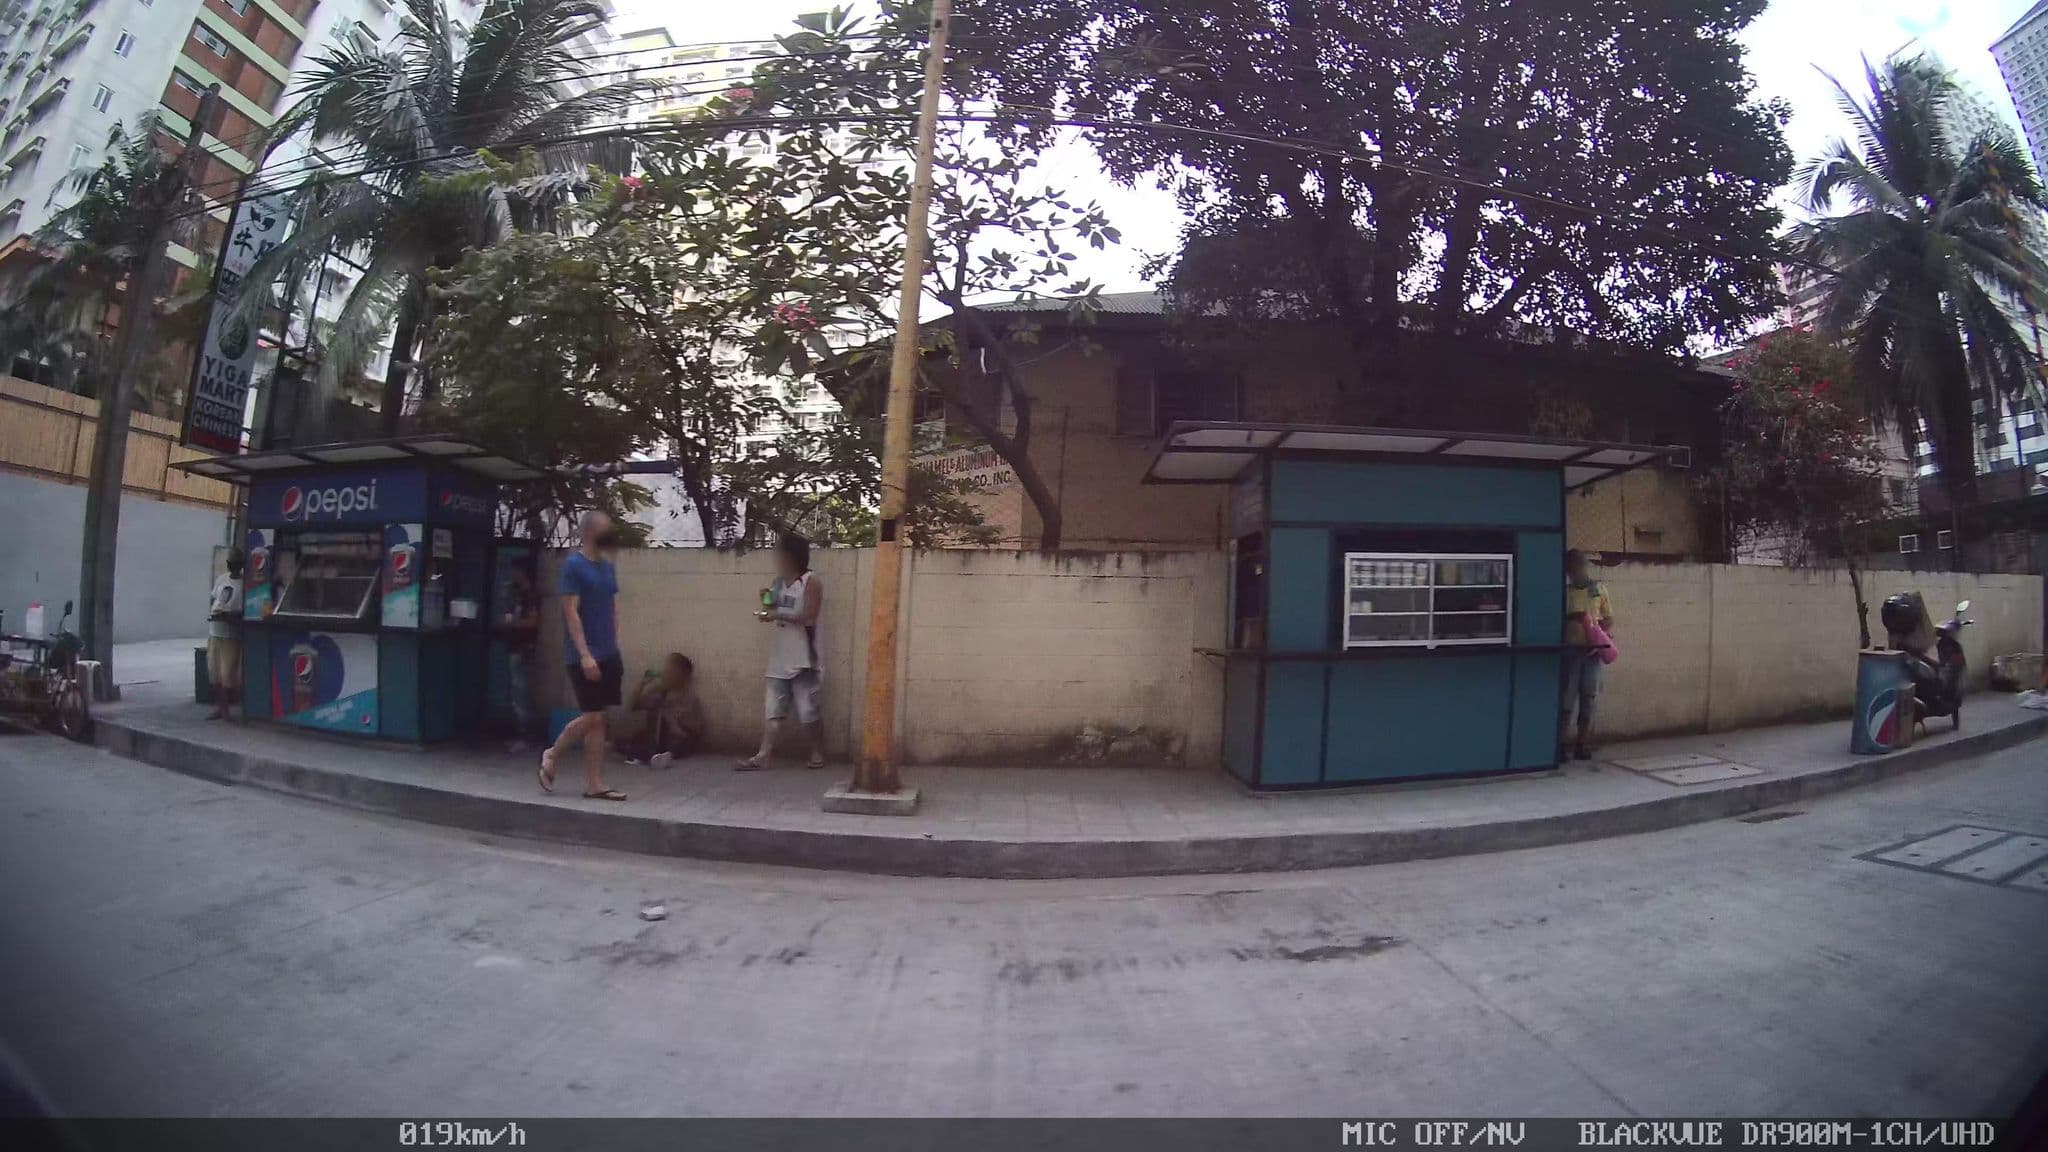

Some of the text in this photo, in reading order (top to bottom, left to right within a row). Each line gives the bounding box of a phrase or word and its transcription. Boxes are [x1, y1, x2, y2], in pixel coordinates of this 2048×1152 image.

[205, 355, 247, 388] YIGA
[200, 375, 248, 406] MART
[195, 397, 241, 421] KOREAN
[193, 413, 241, 437] CHINESE
[305, 478, 377, 520] pepsi
